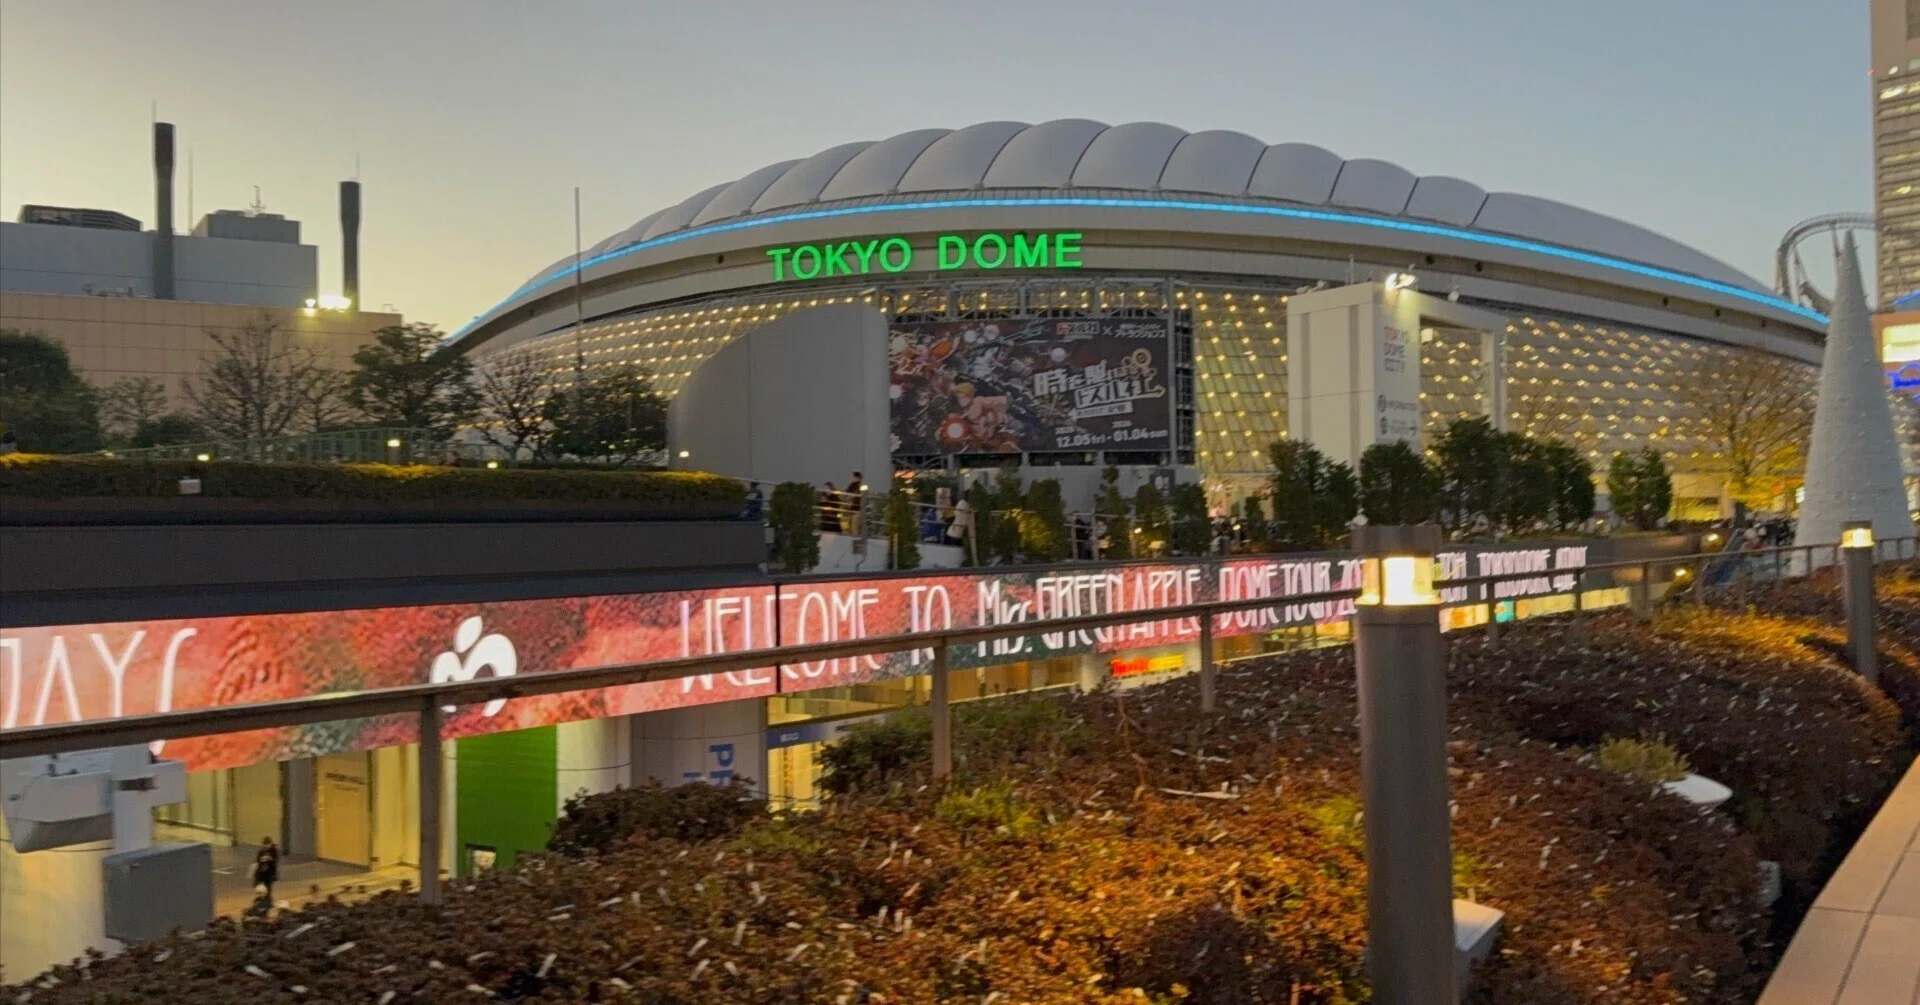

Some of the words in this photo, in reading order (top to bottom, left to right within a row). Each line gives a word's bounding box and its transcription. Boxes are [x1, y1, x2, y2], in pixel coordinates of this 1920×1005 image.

[766, 238, 912, 281] TOKYO
[938, 233, 1083, 270] DOME
[680, 588, 882, 694] WELCOME
[903, 584, 951, 666] TO
[977, 580, 1033, 658] Mrs.
[1036, 573, 1125, 650] GREEN
[1128, 569, 1202, 641] APPLE
[1219, 564, 1280, 630] DOME
[1280, 561, 1333, 623] TOUR
